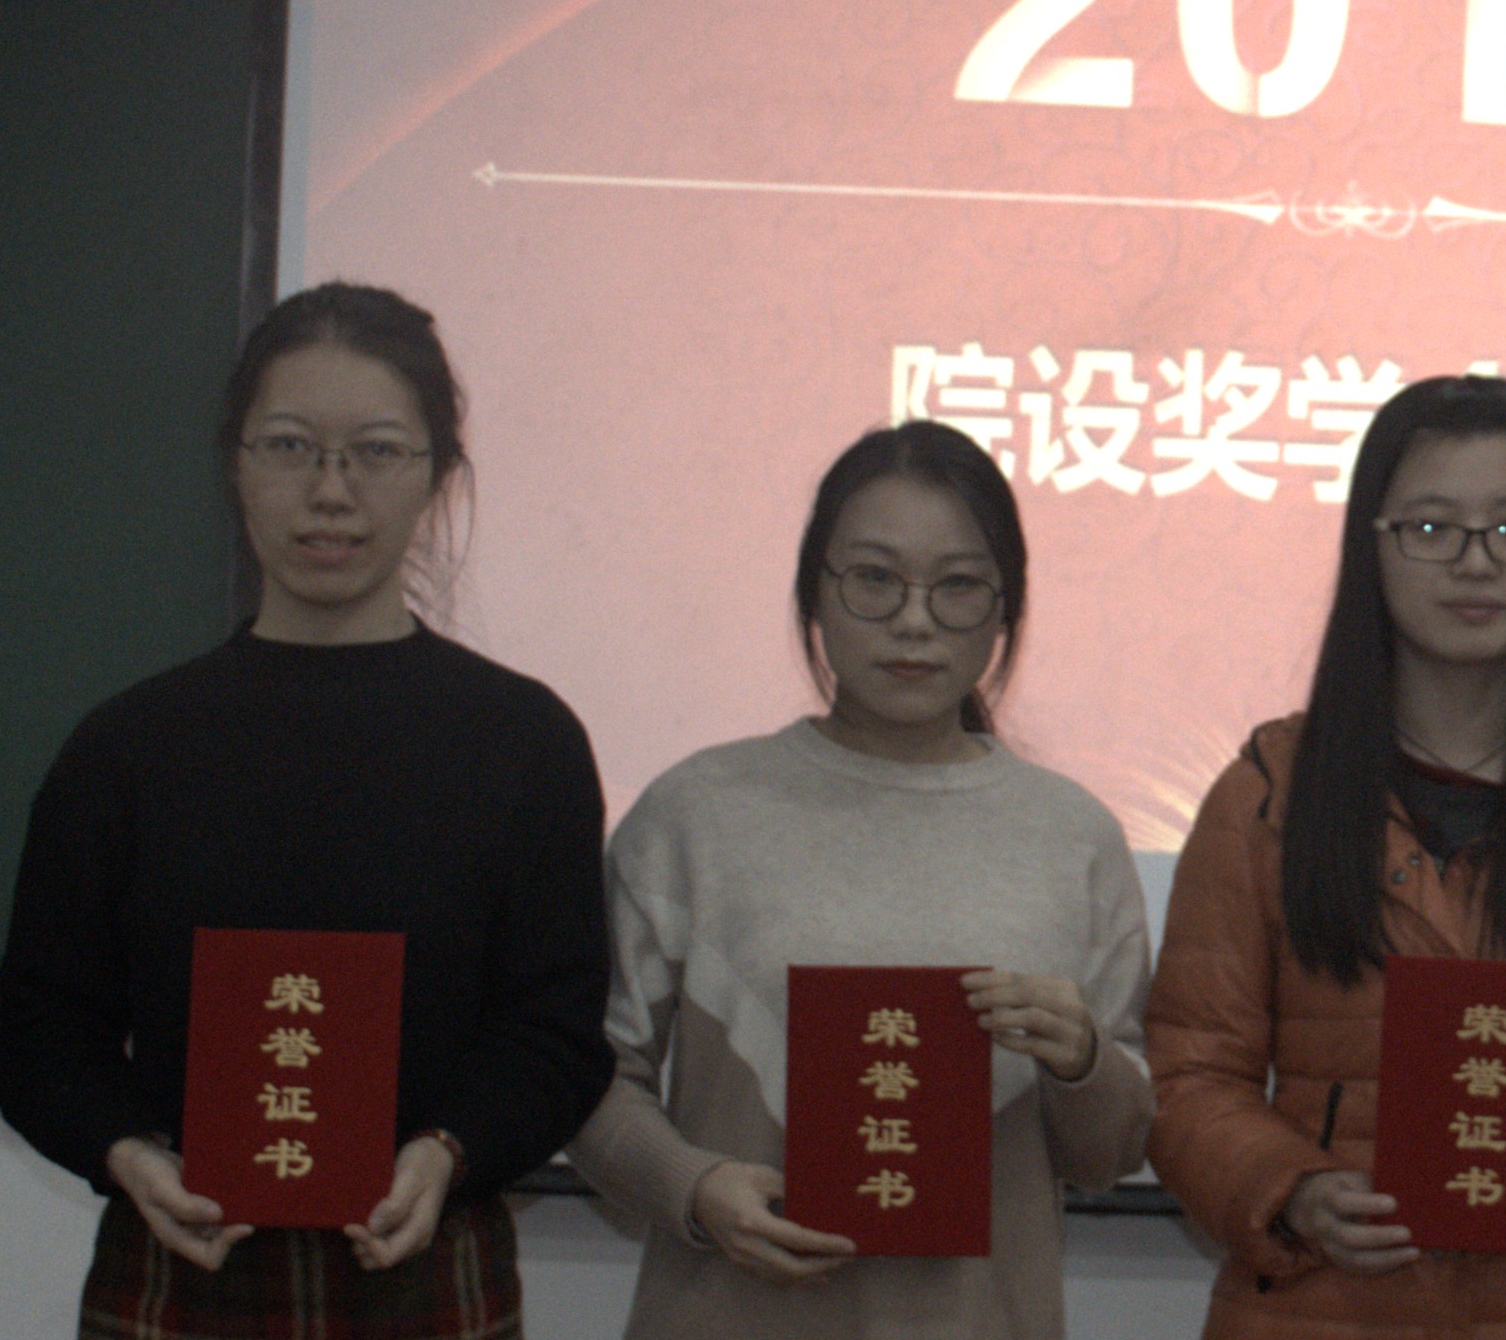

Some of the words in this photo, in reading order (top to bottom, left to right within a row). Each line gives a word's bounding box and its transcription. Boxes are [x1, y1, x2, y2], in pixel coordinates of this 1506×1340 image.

[254, 972, 325, 1180] 荣誉证书
[855, 1007, 921, 1210] 荣誉证书
